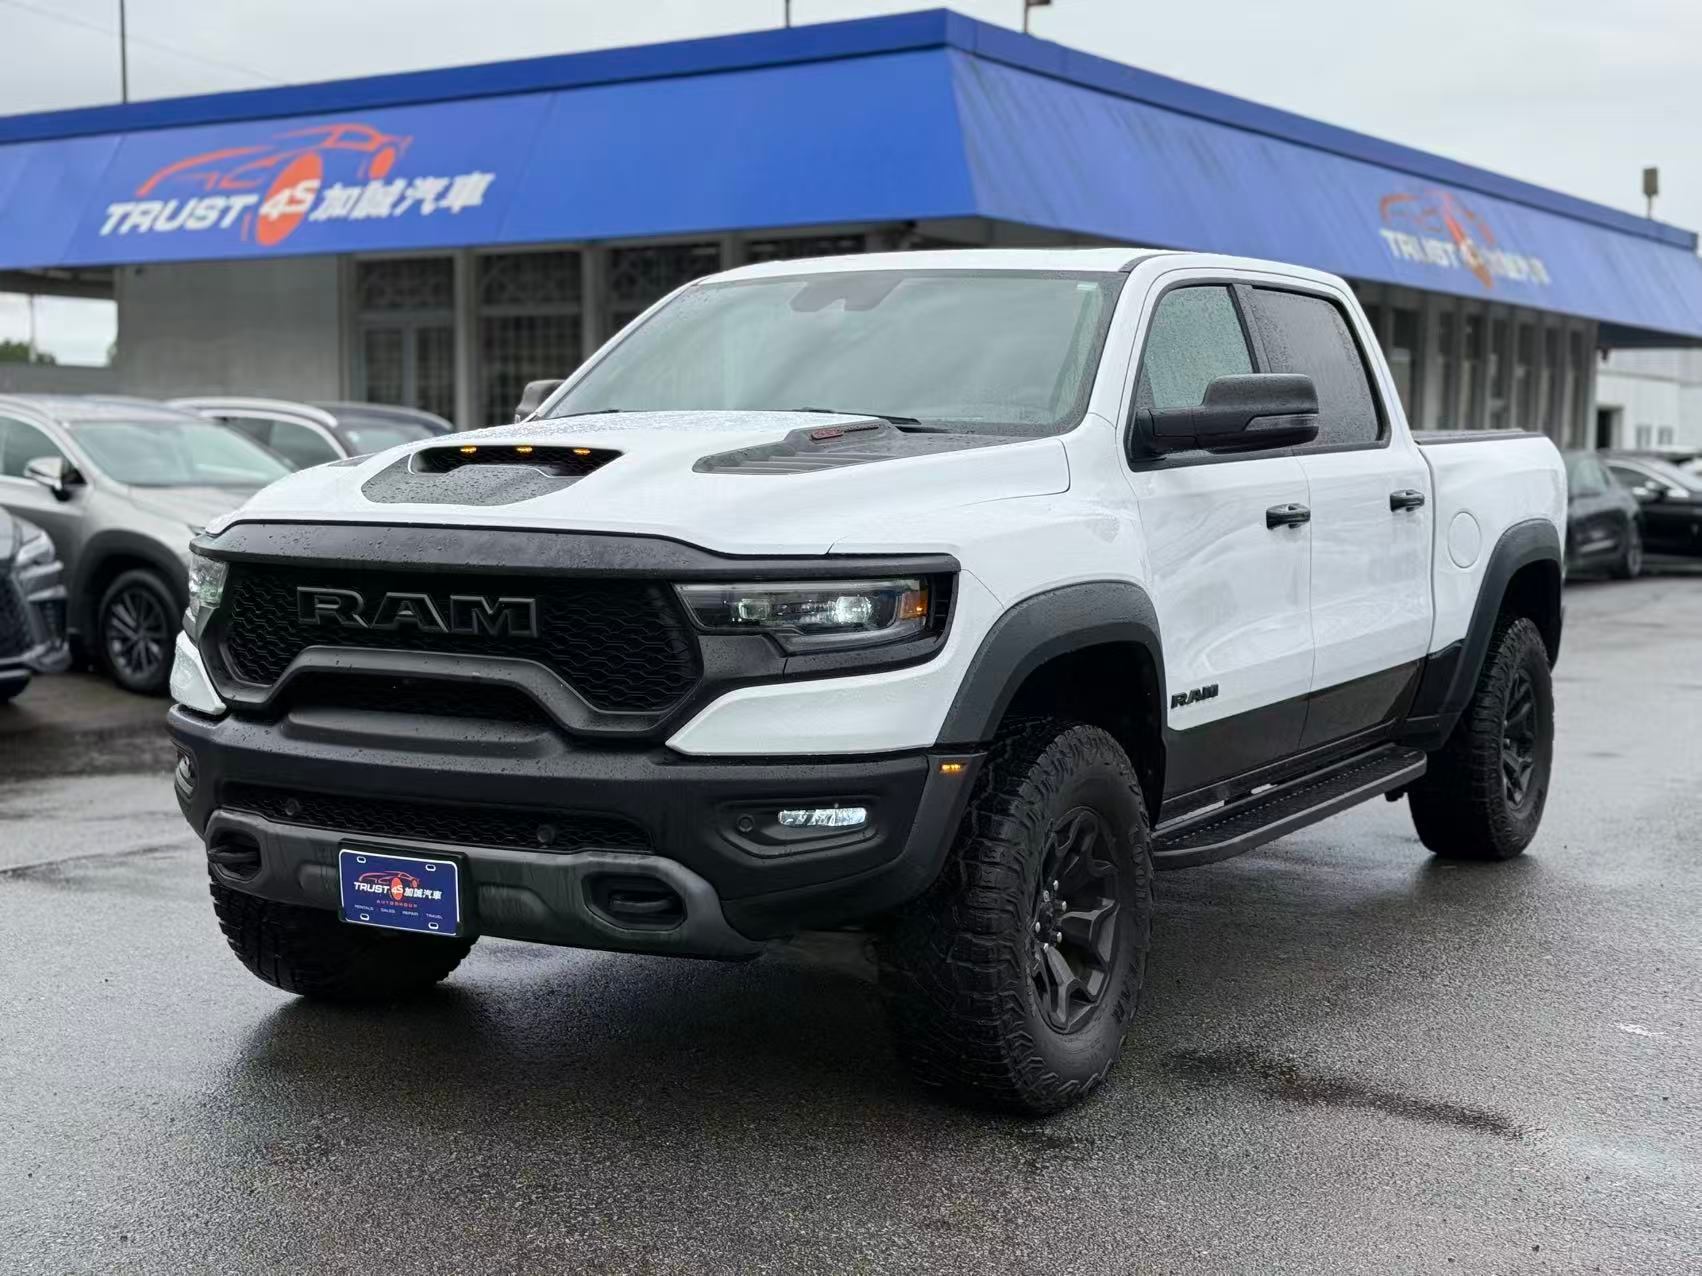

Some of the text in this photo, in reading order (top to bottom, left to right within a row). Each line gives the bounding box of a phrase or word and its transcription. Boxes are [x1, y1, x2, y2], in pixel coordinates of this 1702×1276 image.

[100, 194, 259, 236] TRUST
[258, 179, 320, 219] 4S
[297, 586, 538, 637] RAM
[1170, 684, 1219, 709] RAM
[353, 882, 390, 894] TRUST
[391, 885, 404, 895] 4S
